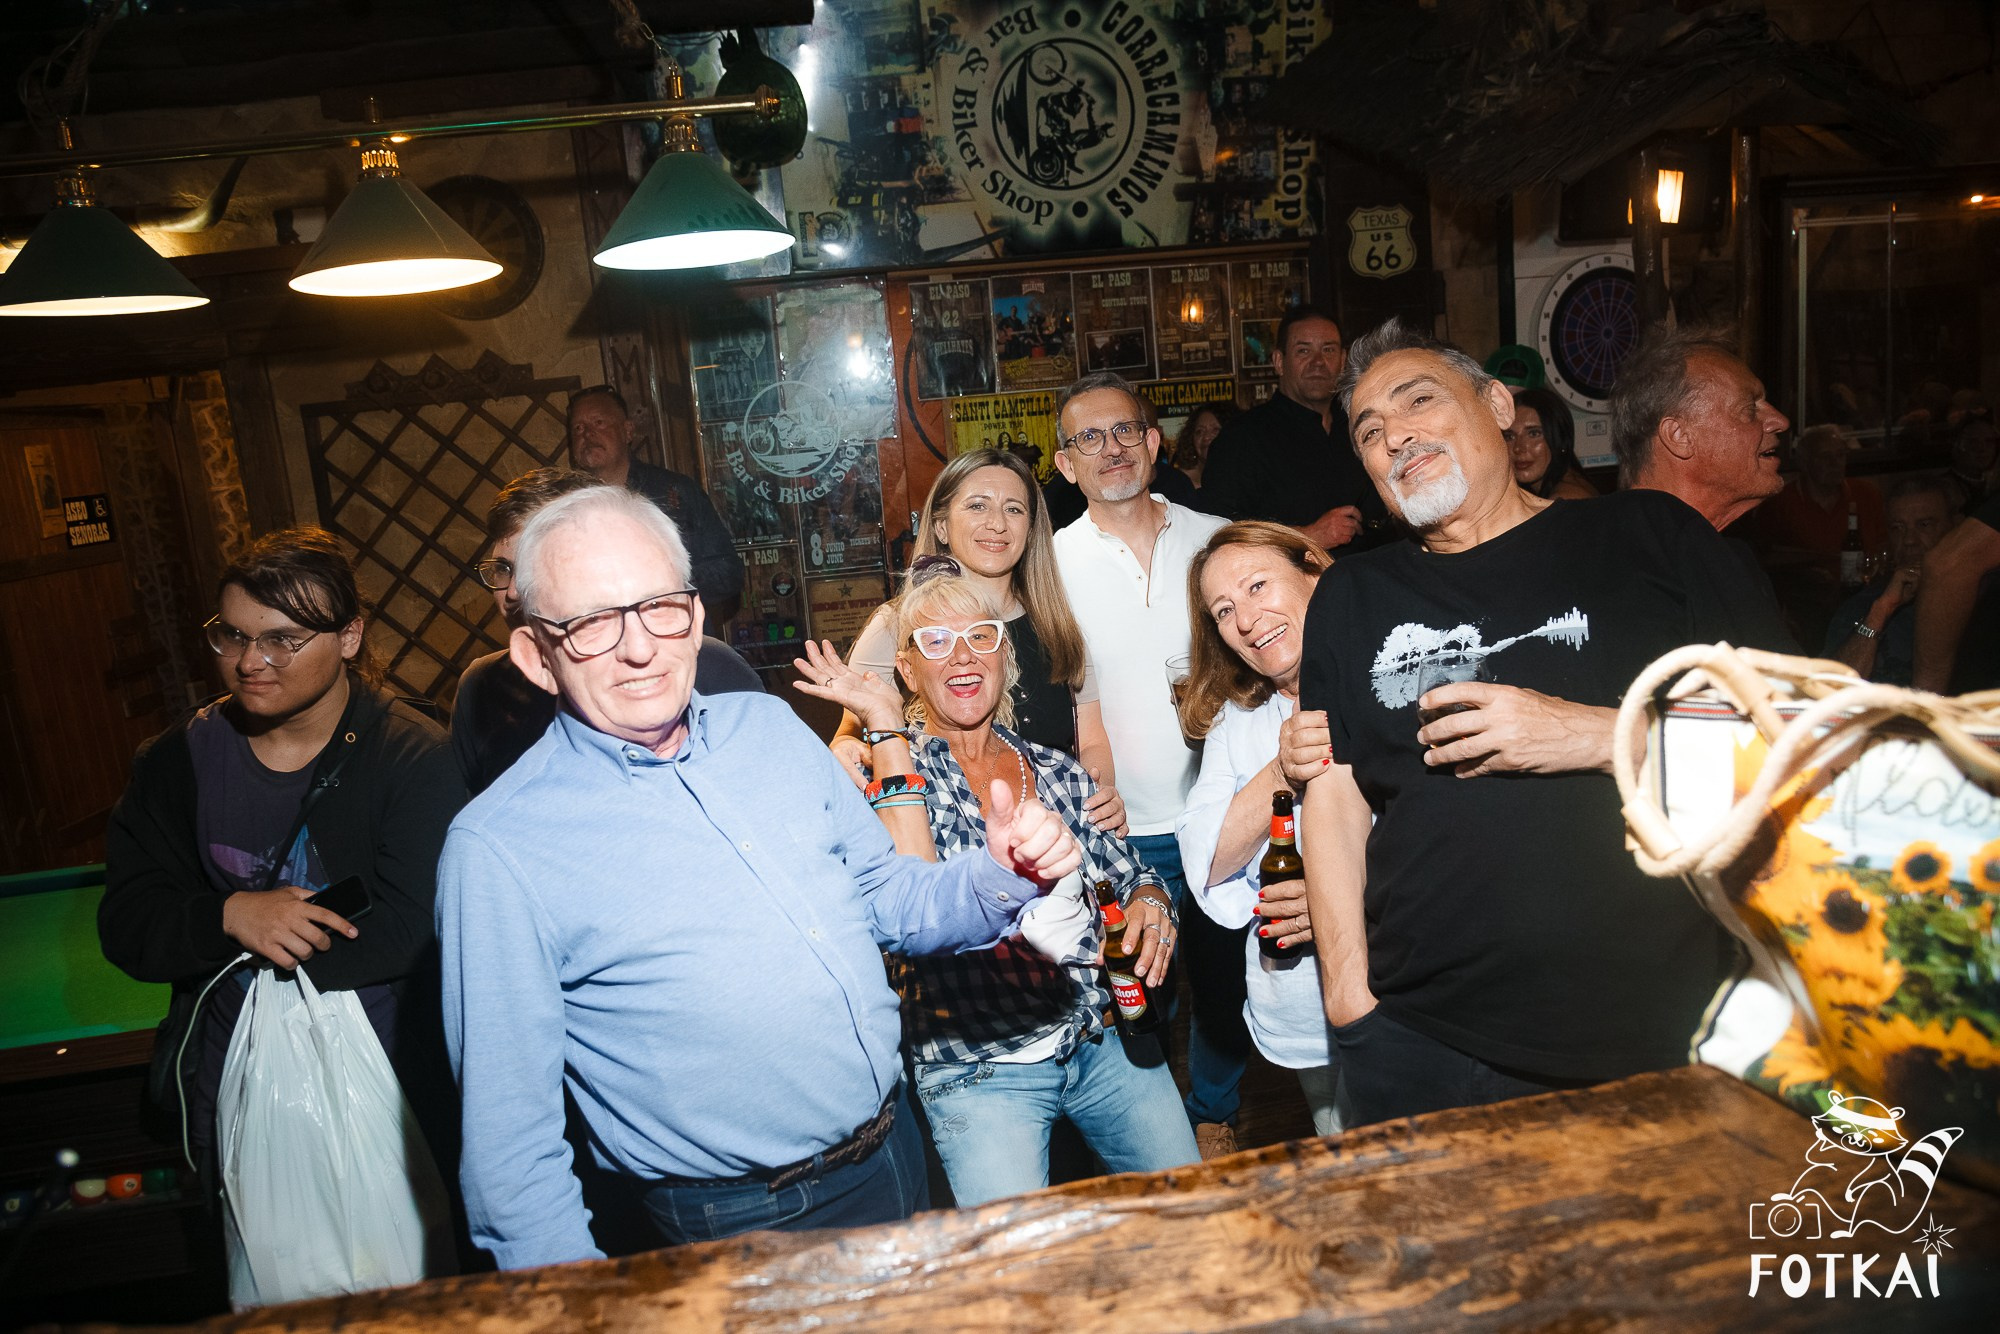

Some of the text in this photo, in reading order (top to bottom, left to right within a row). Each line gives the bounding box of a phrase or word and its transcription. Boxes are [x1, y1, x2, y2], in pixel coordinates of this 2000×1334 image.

[984, 5, 1040, 48] Bar
[1286, 0, 1314, 60] Bik
[959, 47, 989, 77] &
[1101, 0, 1181, 219] CORRECAMINOS
[952, 85, 985, 172] Biker
[980, 169, 1054, 226] Shop
[1361, 214, 1400, 228] TEXAS
[1370, 232, 1393, 243] US
[1366, 244, 1401, 272] 66
[1092, 272, 1132, 289] EL PASO
[1171, 268, 1210, 284] EL PASO
[1249, 262, 1290, 279] EL PASO
[929, 284, 970, 300] EL PASO
[1178, 381, 1233, 404] CAMPILLO
[955, 396, 1051, 423] SANTI CAMPILLO
[984, 421, 1007, 431] POWER
[726, 449, 753, 486] Bar
[754, 480, 773, 501] &
[778, 482, 832, 504] Biker
[65, 501, 88, 522] ASEO
[755, 549, 779, 565] PASO
[810, 532, 824, 566] 8
[825, 541, 845, 553] JUNIO
[826, 553, 844, 564] JUNE
[1113, 986, 1140, 999] ahou
